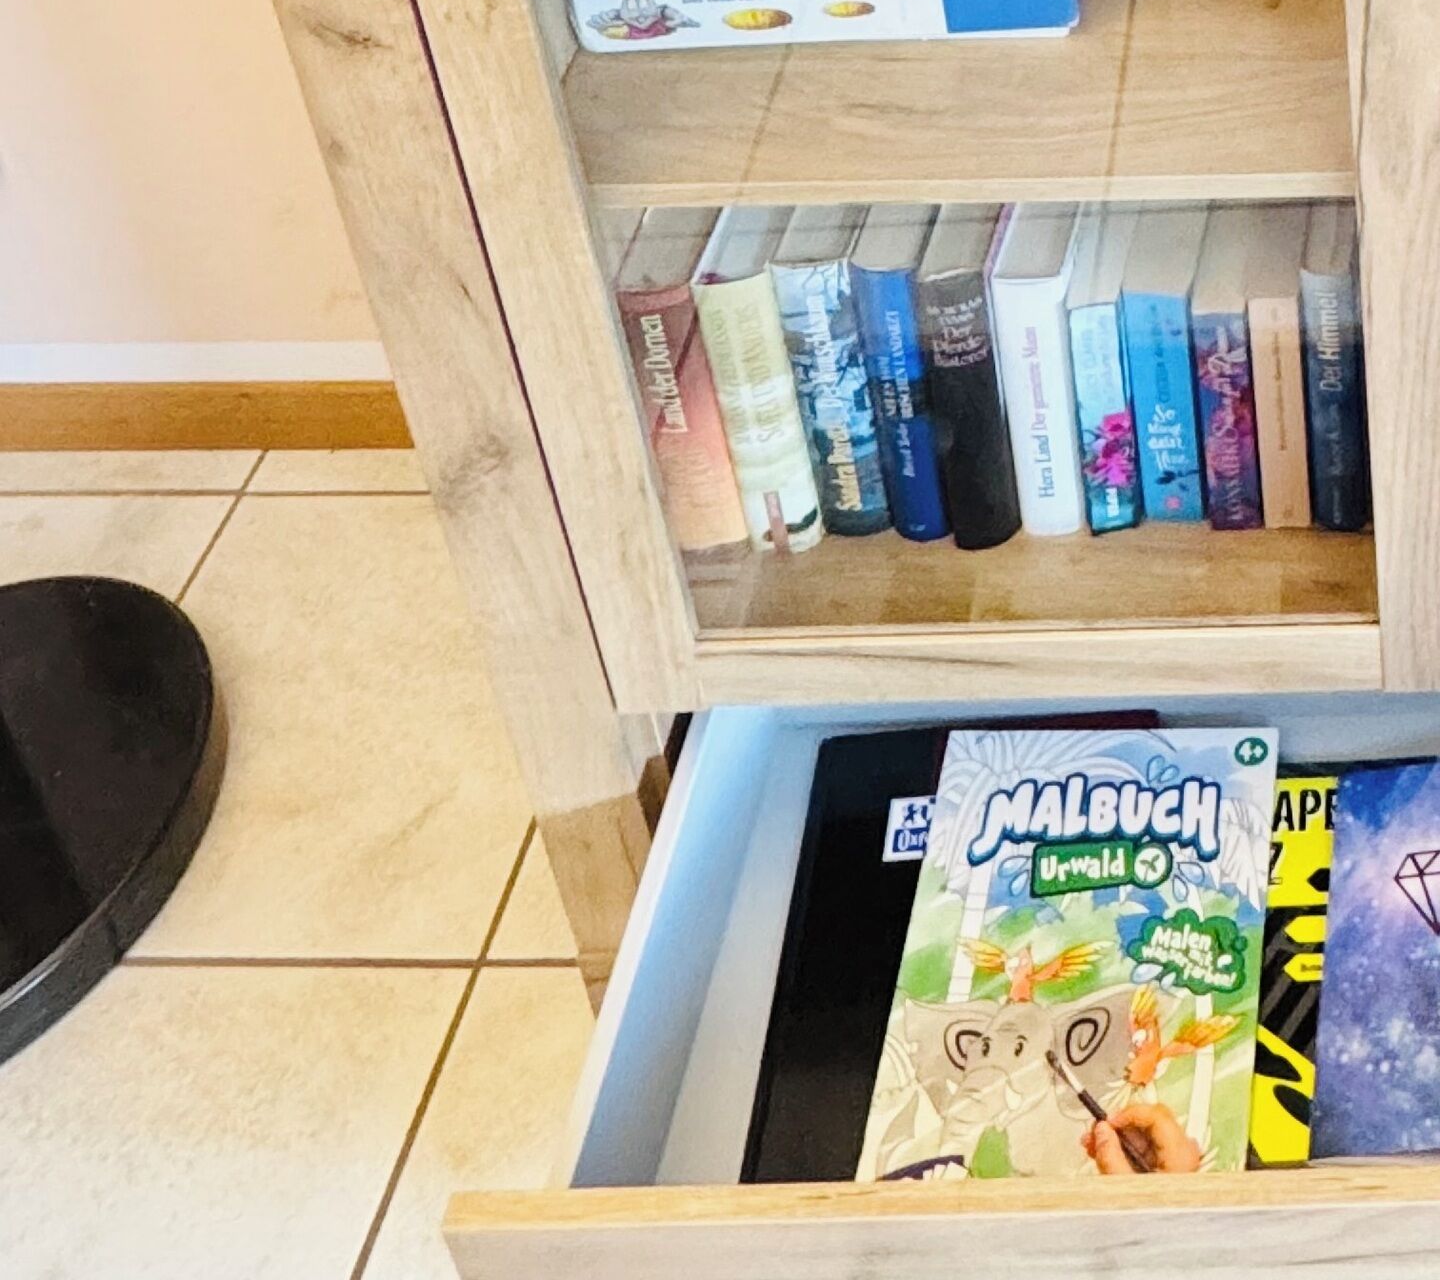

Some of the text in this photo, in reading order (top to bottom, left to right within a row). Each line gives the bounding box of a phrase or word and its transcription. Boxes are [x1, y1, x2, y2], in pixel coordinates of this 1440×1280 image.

[1316, 292, 1342, 360] Himmel
[1319, 366, 1343, 392] Der
[1032, 434, 1052, 463] Lind
[1039, 467, 1055, 499] Hera
[1238, 741, 1266, 763] 4+
[967, 773, 1222, 865] MALBUCH
[1273, 790, 1337, 833] APE
[1040, 847, 1127, 882] Urwald
[1150, 923, 1213, 952] Malen
